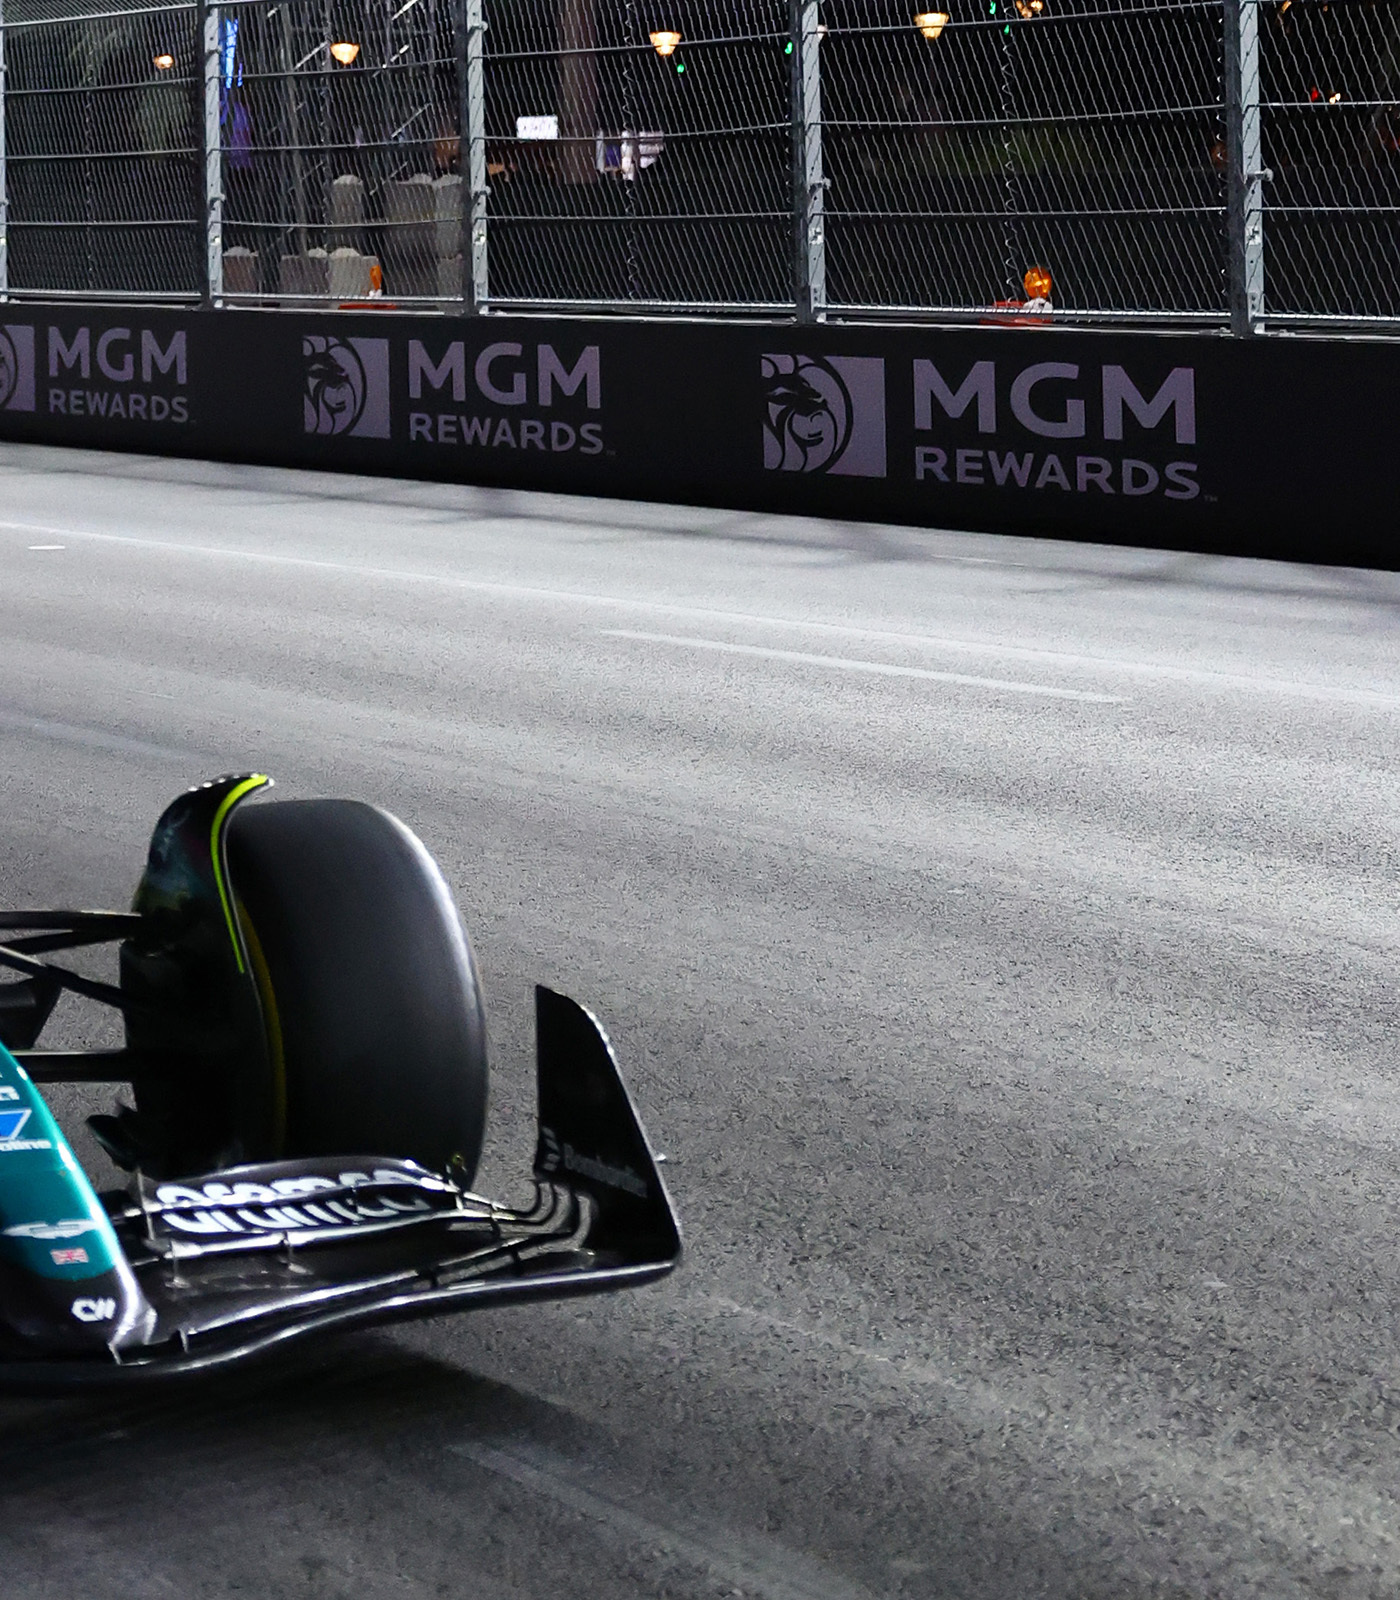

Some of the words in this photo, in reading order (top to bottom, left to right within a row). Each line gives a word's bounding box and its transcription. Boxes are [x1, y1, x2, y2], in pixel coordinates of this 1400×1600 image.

[48, 325, 187, 385] MGM
[408, 339, 601, 409] MGM
[49, 388, 188, 422] REWARDS
[912, 358, 1196, 445] MGM
[409, 412, 603, 454] REWARDS
[915, 446, 1201, 500] REWARDS
